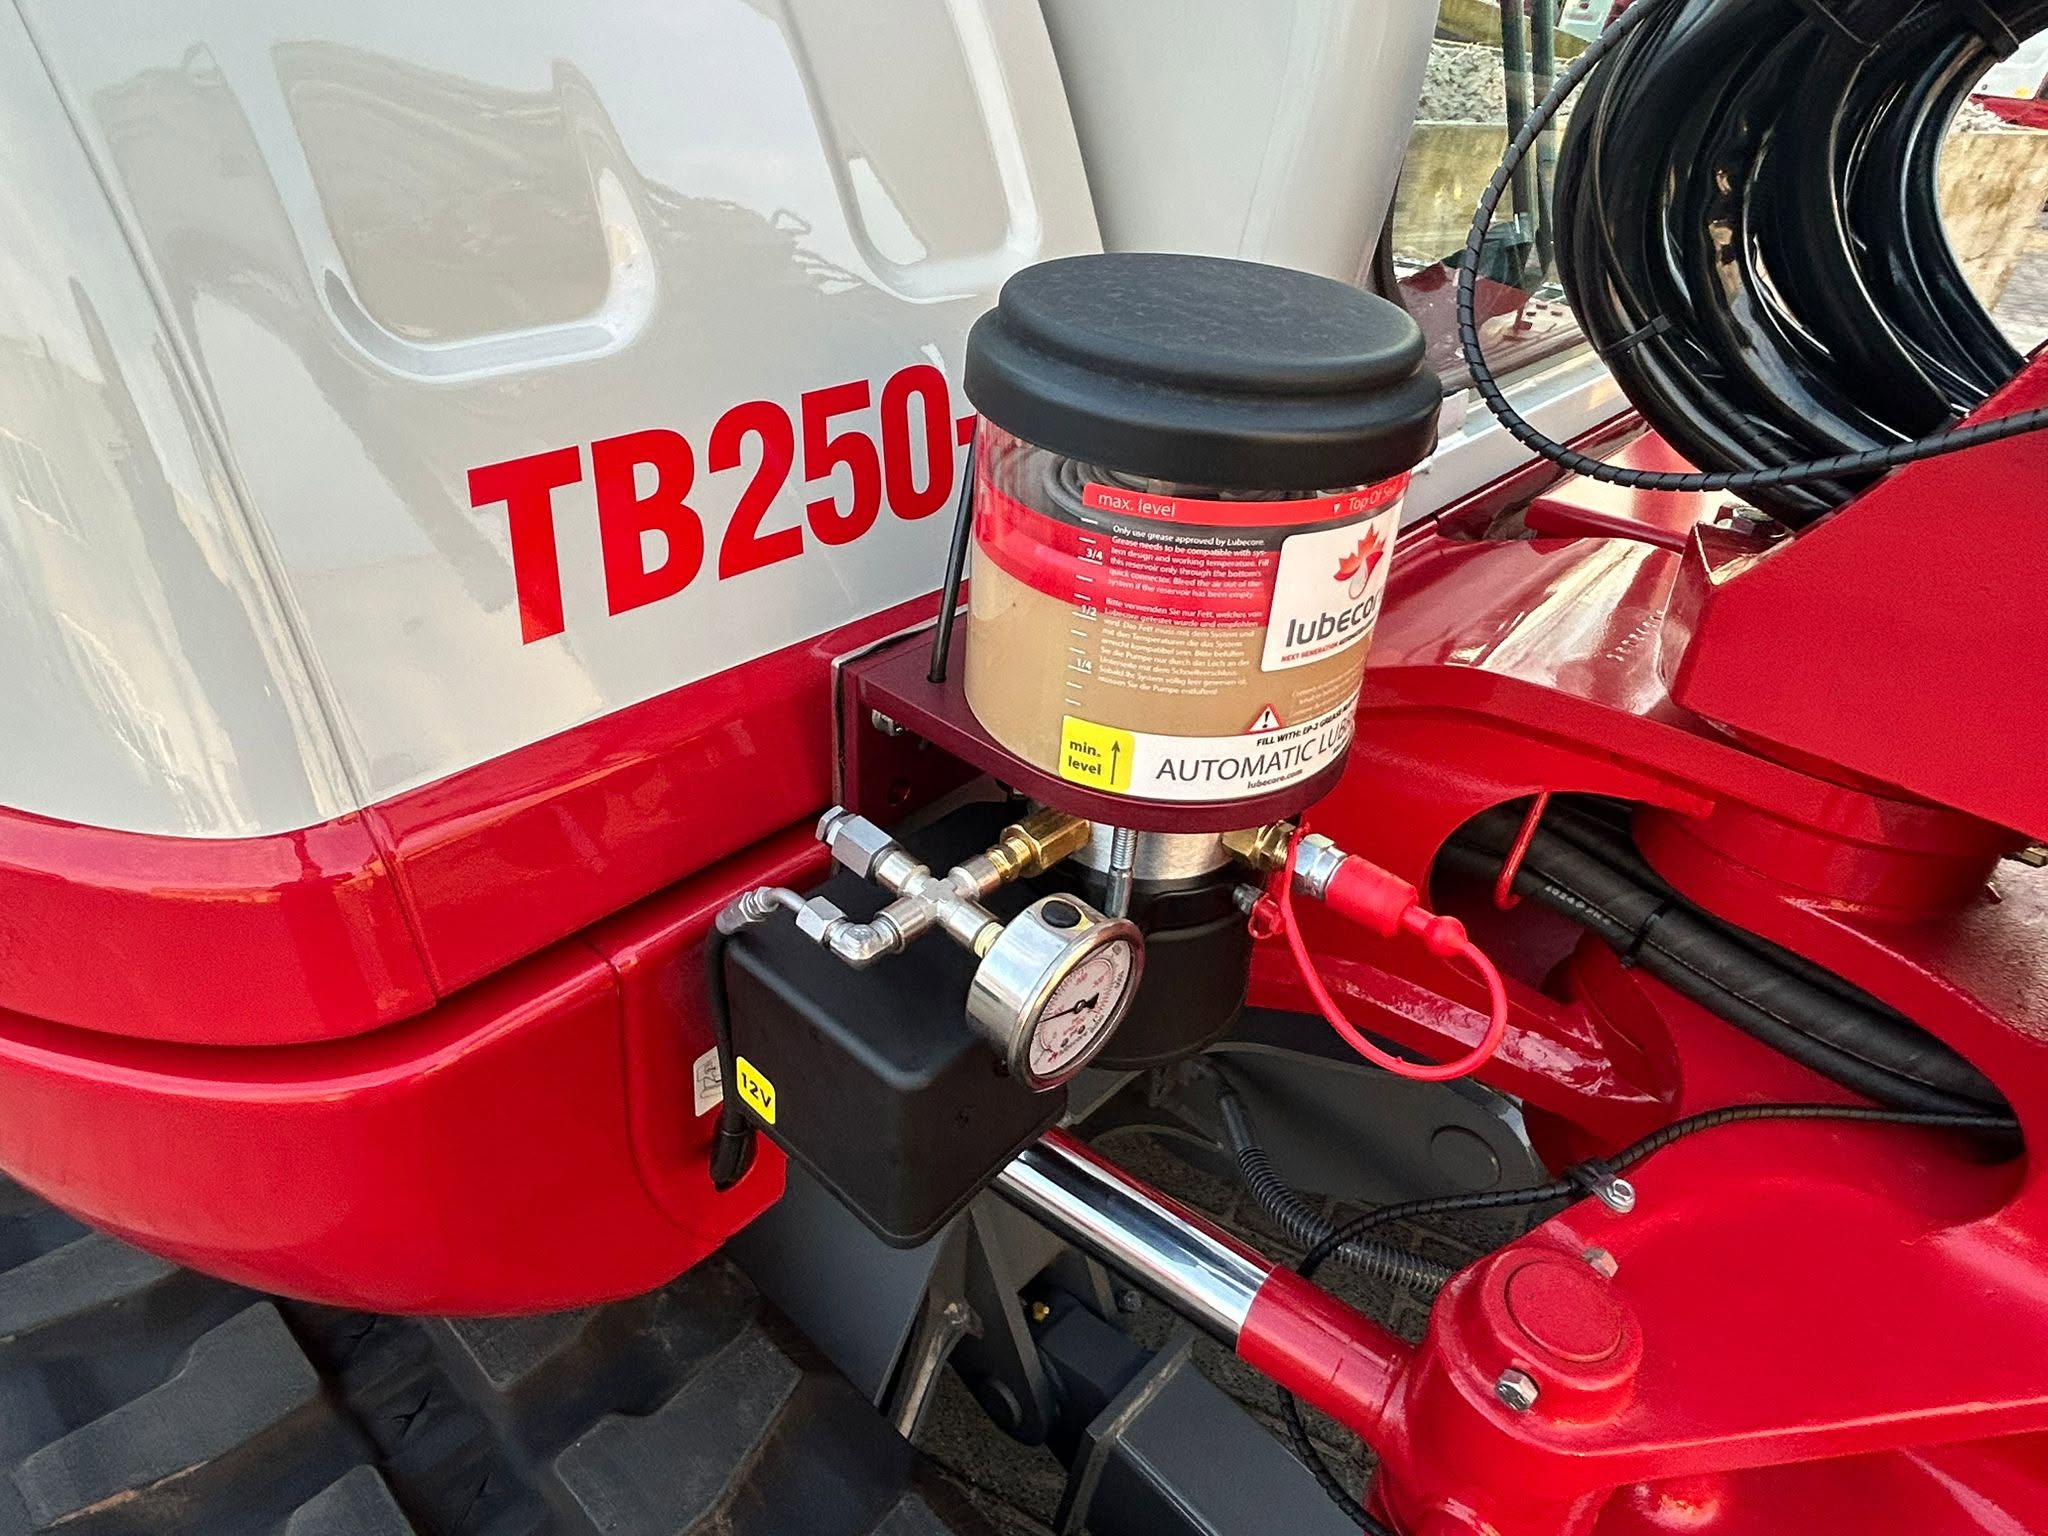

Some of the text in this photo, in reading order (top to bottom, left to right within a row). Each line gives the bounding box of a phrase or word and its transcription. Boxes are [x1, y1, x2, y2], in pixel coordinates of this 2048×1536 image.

[1098, 494, 1176, 517] max. level
[1349, 497, 1369, 511] Top
[1370, 490, 1384, 504] Of
[1112, 536, 1138, 548] Grease
[1139, 542, 1163, 551] needs
[1113, 525, 1131, 536] Only
[1132, 530, 1146, 538] use
[1147, 532, 1174, 542] grease
[1175, 537, 1214, 545] approved
[1216, 538, 1226, 547] by
[1086, 548, 1104, 560] 3/4
[1111, 547, 1126, 556] tem
[1128, 551, 1154, 561] design
[1172, 558, 1204, 568] working
[1110, 557, 1124, 566] this
[1125, 562, 1160, 571] reservoir
[1160, 566, 1178, 576] only
[1180, 567, 1212, 578] through
[1173, 577, 1196, 586] Bleed
[1156, 588, 1191, 596] reservoir
[1082, 605, 1098, 616] 1/2
[1076, 658, 1092, 670] 1/4
[1281, 652, 1300, 662] NEXT
[1256, 736, 1276, 746] FILL
[1277, 731, 1302, 742] WITH:
[1070, 739, 1102, 758] min.
[1068, 756, 1102, 776] level
[1156, 738, 1316, 782] AUTOMATIC
[1247, 768, 1303, 789] lubecore.com
[742, 1072, 772, 1108] 12V
